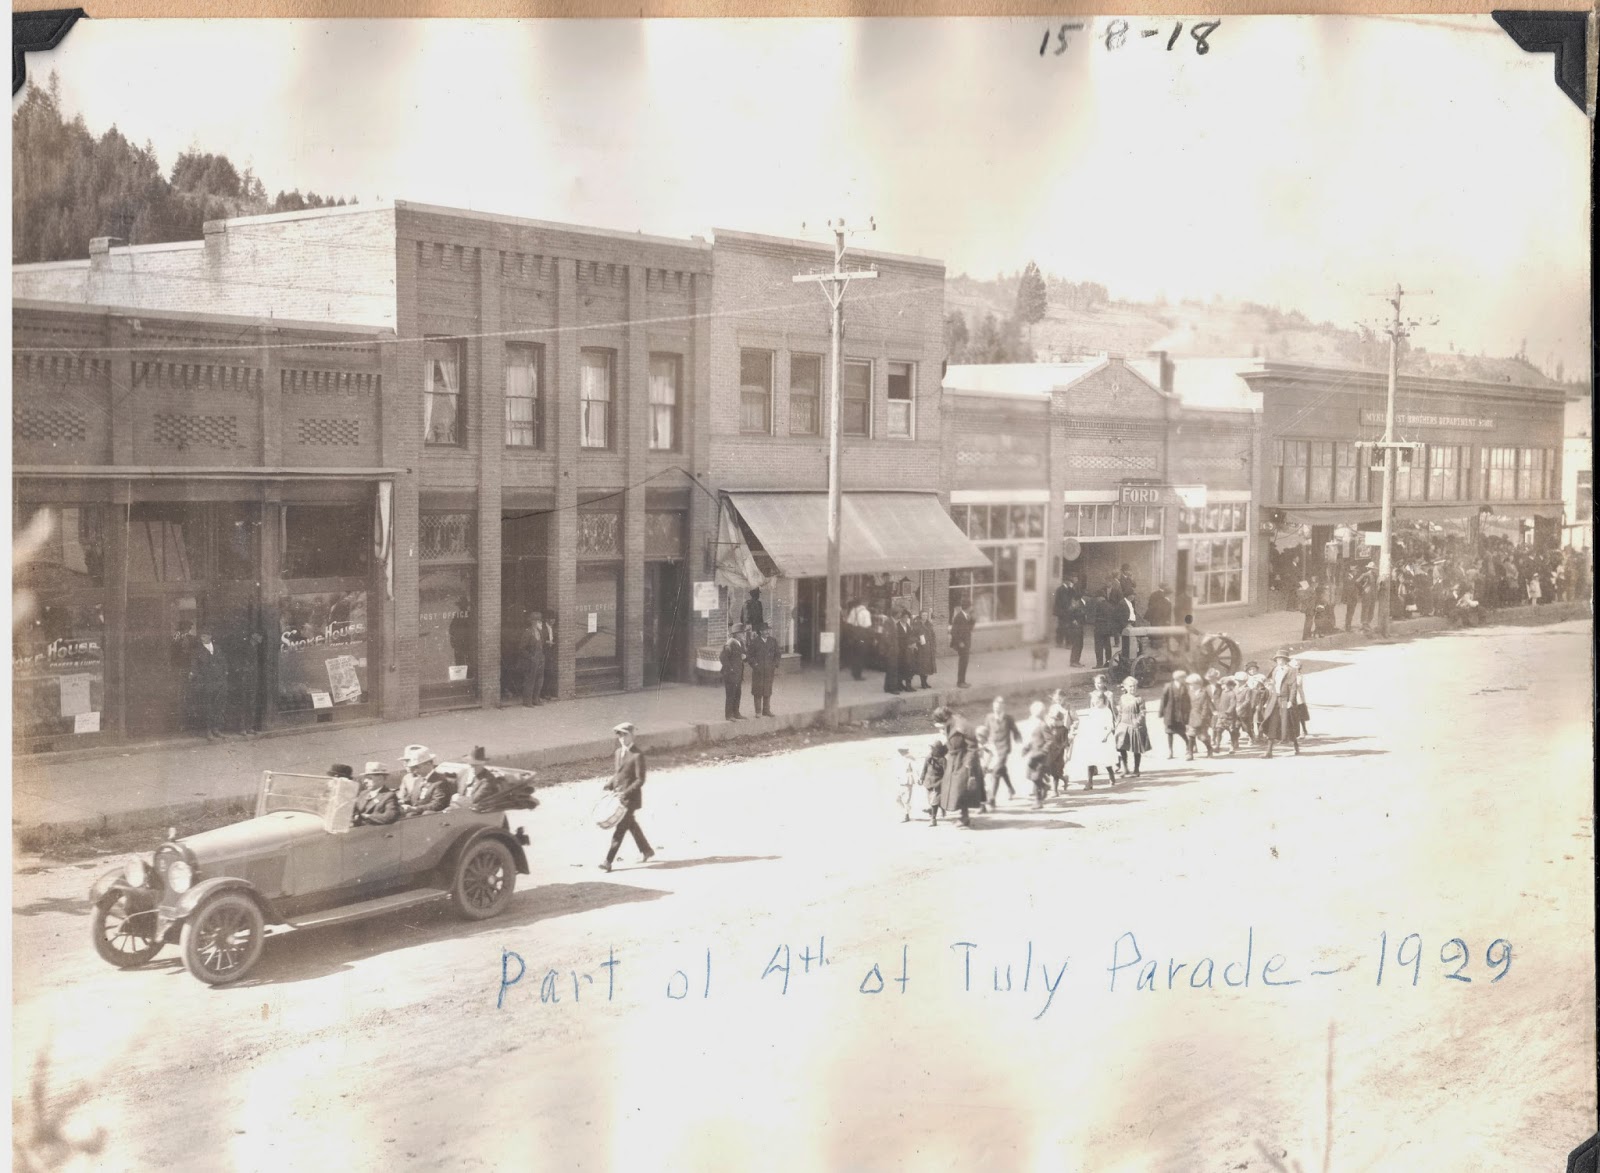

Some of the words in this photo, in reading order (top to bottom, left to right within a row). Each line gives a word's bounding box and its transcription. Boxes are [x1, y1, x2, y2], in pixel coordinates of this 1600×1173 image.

[1407, 415, 1438, 426] BROTHERS
[1439, 416, 1476, 427] DEPARTMENT
[1122, 487, 1160, 503] FORD
[419, 612, 438, 621] POST
[442, 610, 469, 620] OFFICE
